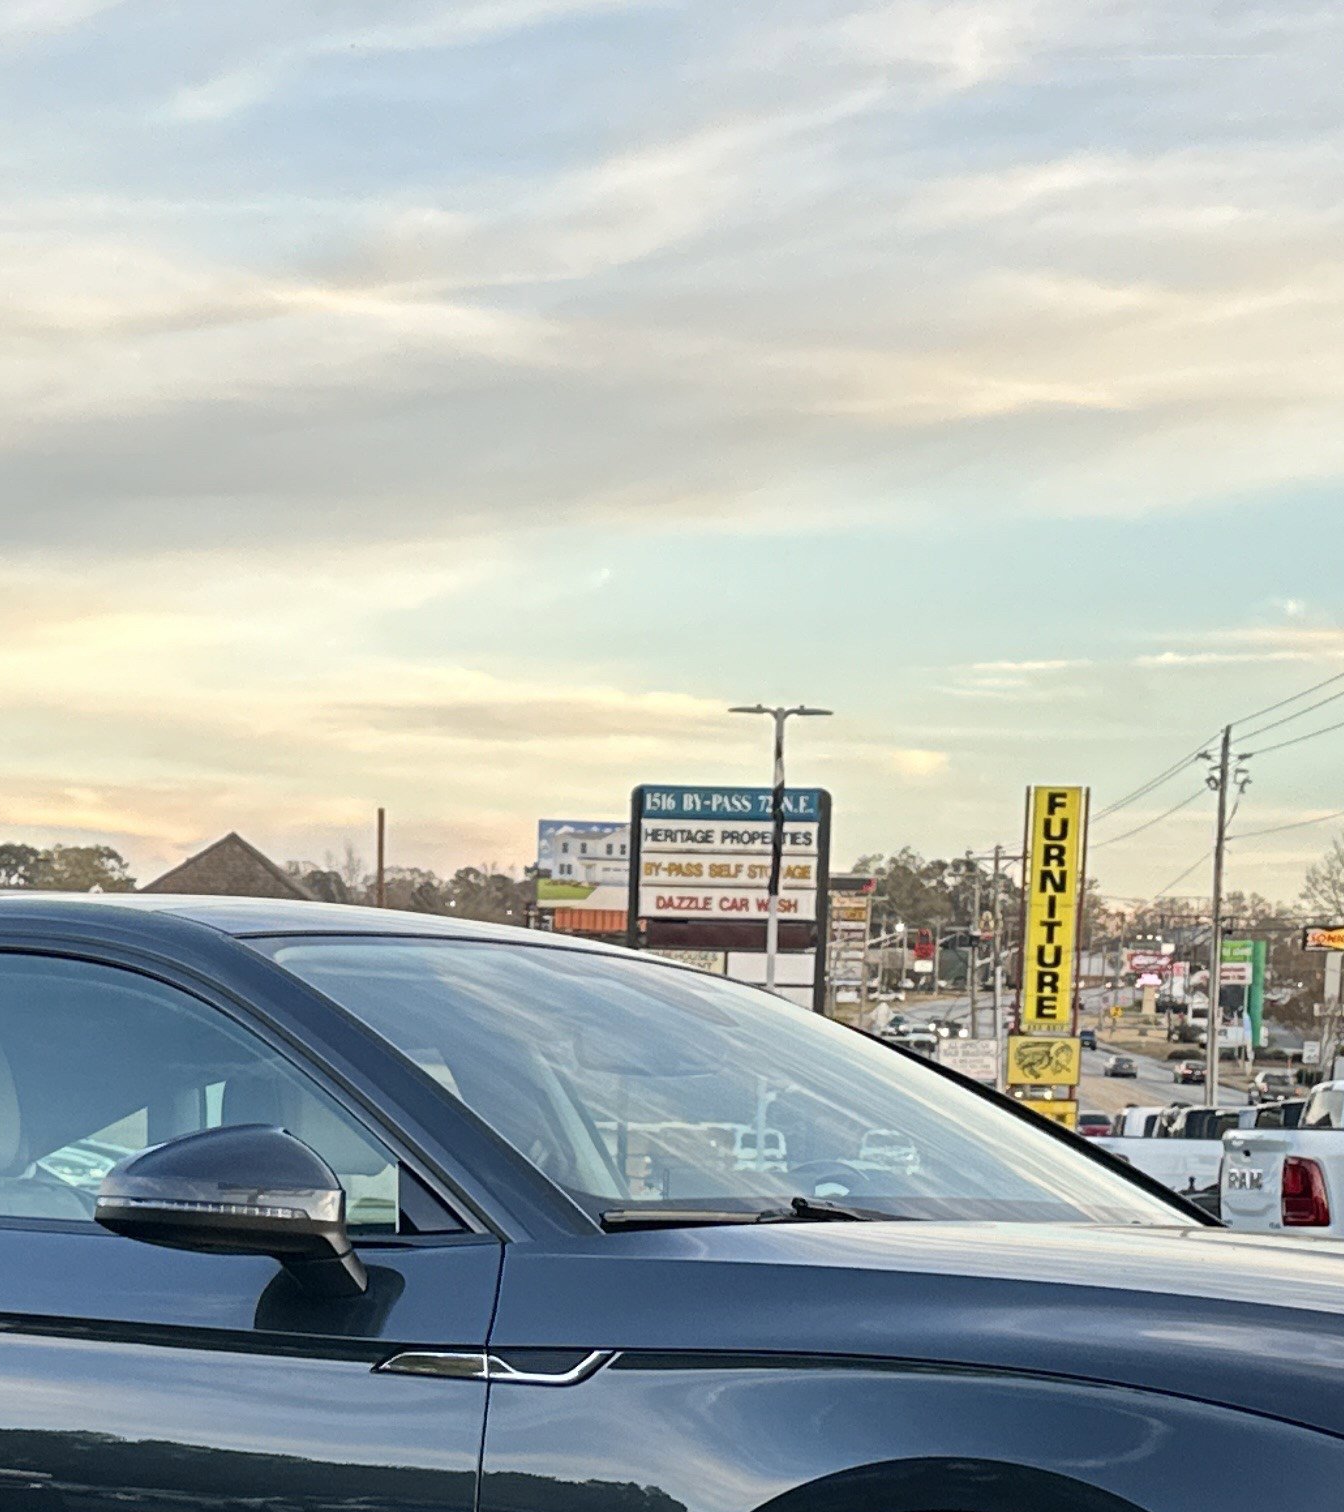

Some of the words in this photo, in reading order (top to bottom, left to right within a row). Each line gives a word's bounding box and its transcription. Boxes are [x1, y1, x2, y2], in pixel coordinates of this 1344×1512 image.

[645, 791, 676, 812] 1516
[682, 792, 752, 813] BY-PASS
[644, 827, 715, 845] HERITAGE
[721, 828, 813, 847] PROPETIES
[643, 861, 704, 878] BY-PASS
[709, 862, 744, 879] SELF
[655, 895, 713, 911] DAZZLE
[718, 896, 750, 912] CAR
[756, 898, 799, 914] WSH
[1035, 792, 1069, 1020] FURNITURE
[1228, 1168, 1265, 1192] RAM
